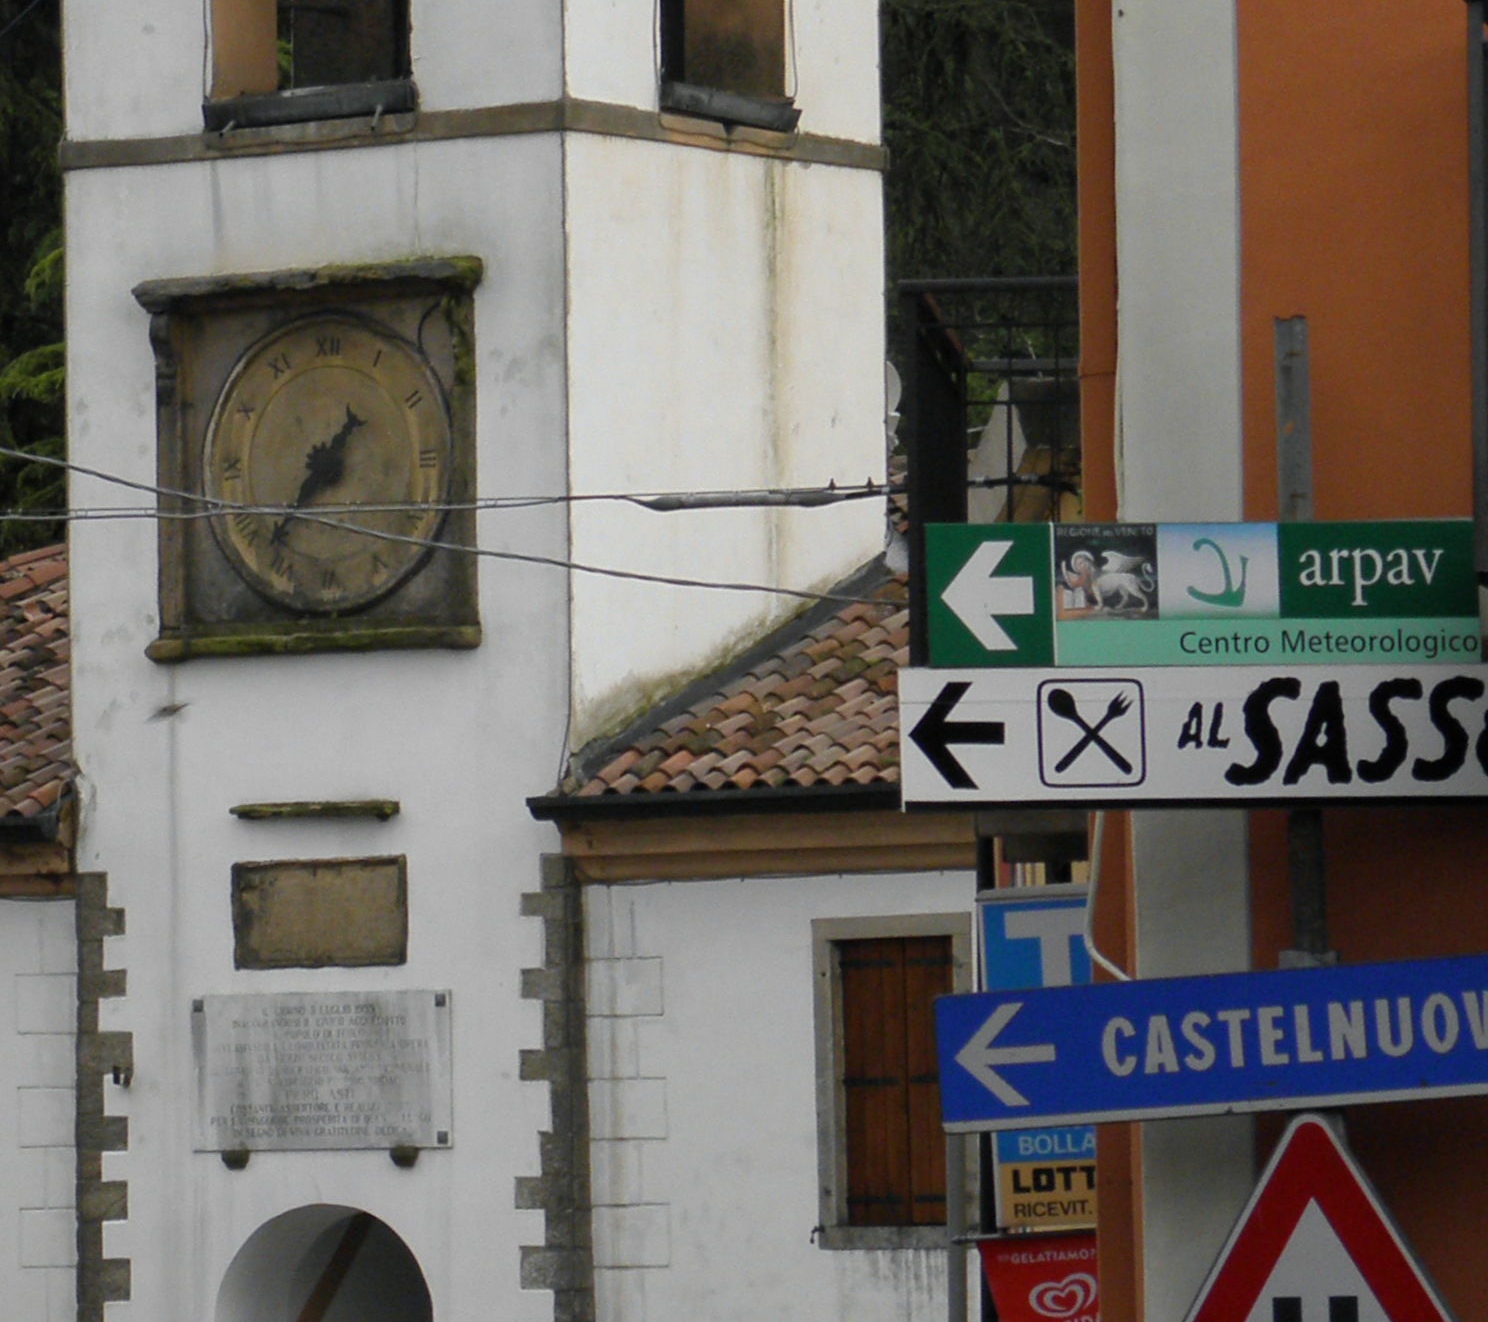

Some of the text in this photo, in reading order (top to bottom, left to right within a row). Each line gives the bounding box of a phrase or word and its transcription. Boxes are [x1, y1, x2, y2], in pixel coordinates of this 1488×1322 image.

[1297, 546, 1445, 607] arpav
[1179, 628, 1479, 659] Centro Meteorologico
[1177, 676, 1488, 787] AL SASS
[1017, 1132, 1096, 1156] BOLLA
[1012, 1165, 1096, 1194] LOTT
[1013, 1199, 1093, 1218] RICEVIT.
